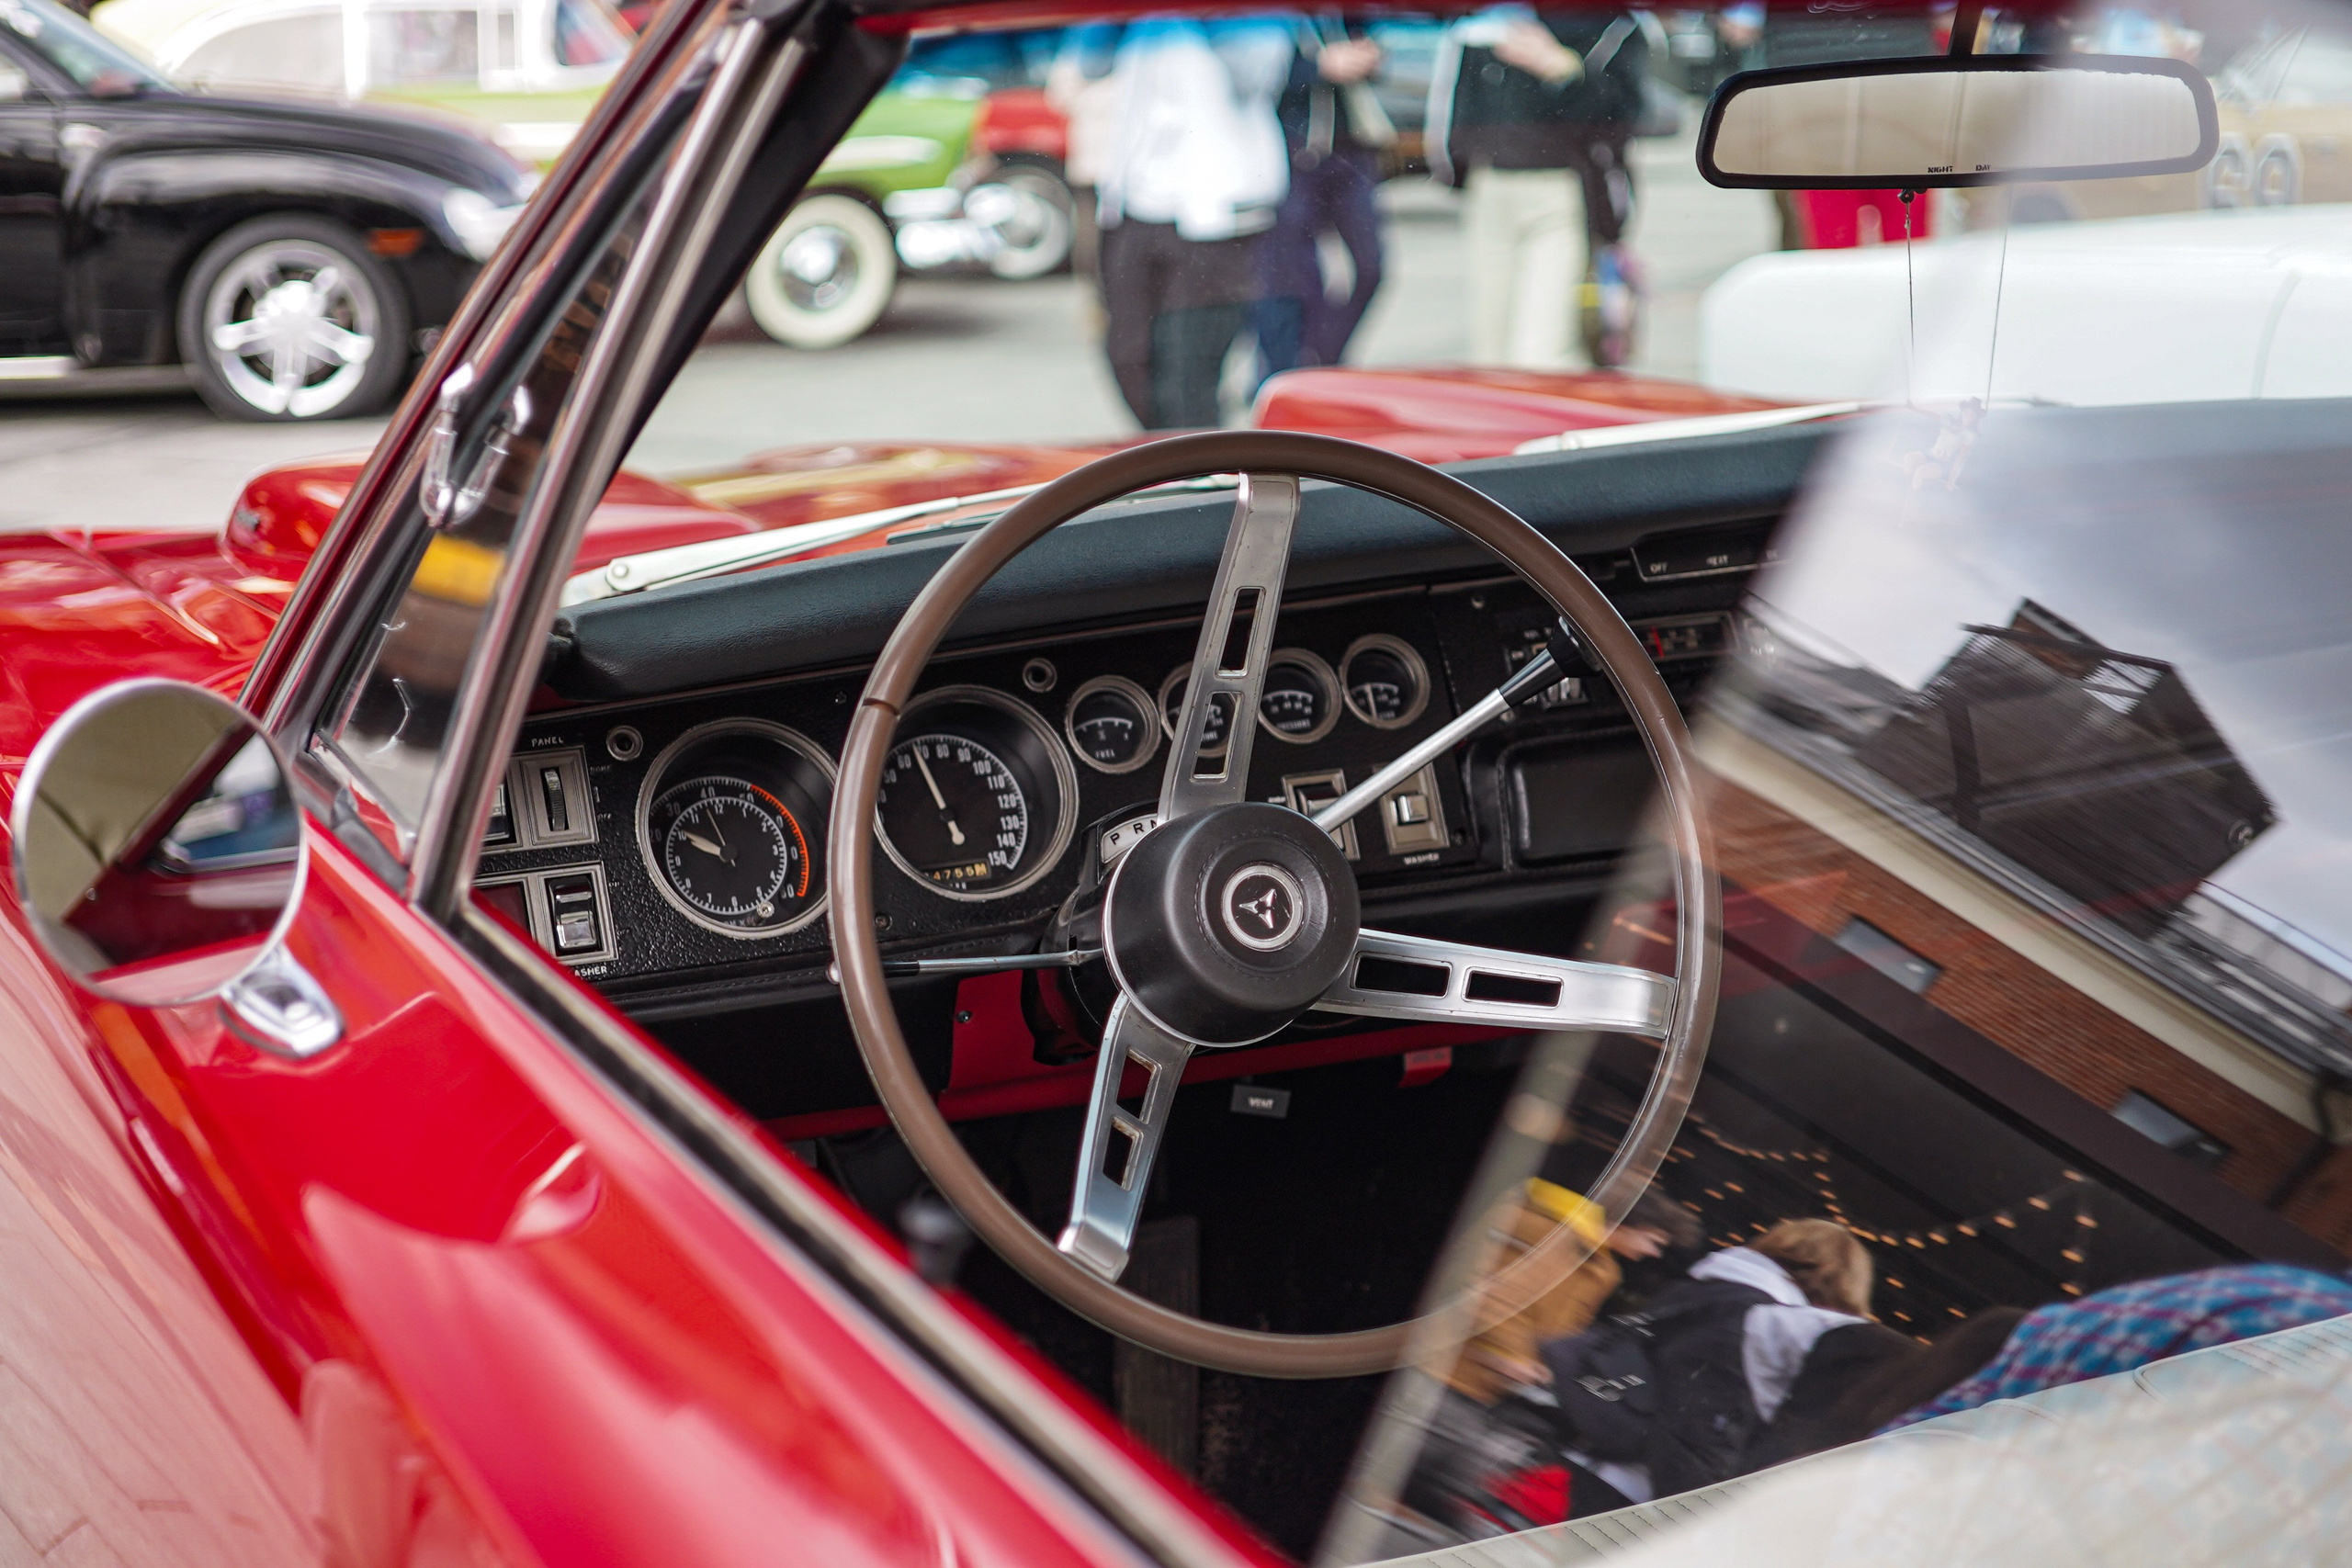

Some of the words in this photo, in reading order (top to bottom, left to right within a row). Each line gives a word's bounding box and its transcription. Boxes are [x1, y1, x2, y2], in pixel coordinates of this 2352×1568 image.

[1649, 561, 1668, 574] OFF
[532, 736, 564, 747] PANEL
[935, 743, 949, 758] 80
[957, 748, 971, 762] 90
[1095, 749, 1115, 760] FUEL
[972, 760, 991, 775] 100
[987, 775, 1005, 790] 110
[700, 785, 716, 799] 40
[998, 794, 1017, 809] 120
[714, 804, 724, 815] 12
[1000, 814, 1020, 830] 130
[997, 832, 1016, 848] 140
[1110, 832, 1120, 845] P
[1134, 822, 1145, 834] R
[988, 850, 1007, 866] 150
[1404, 852, 1441, 865] WASHER
